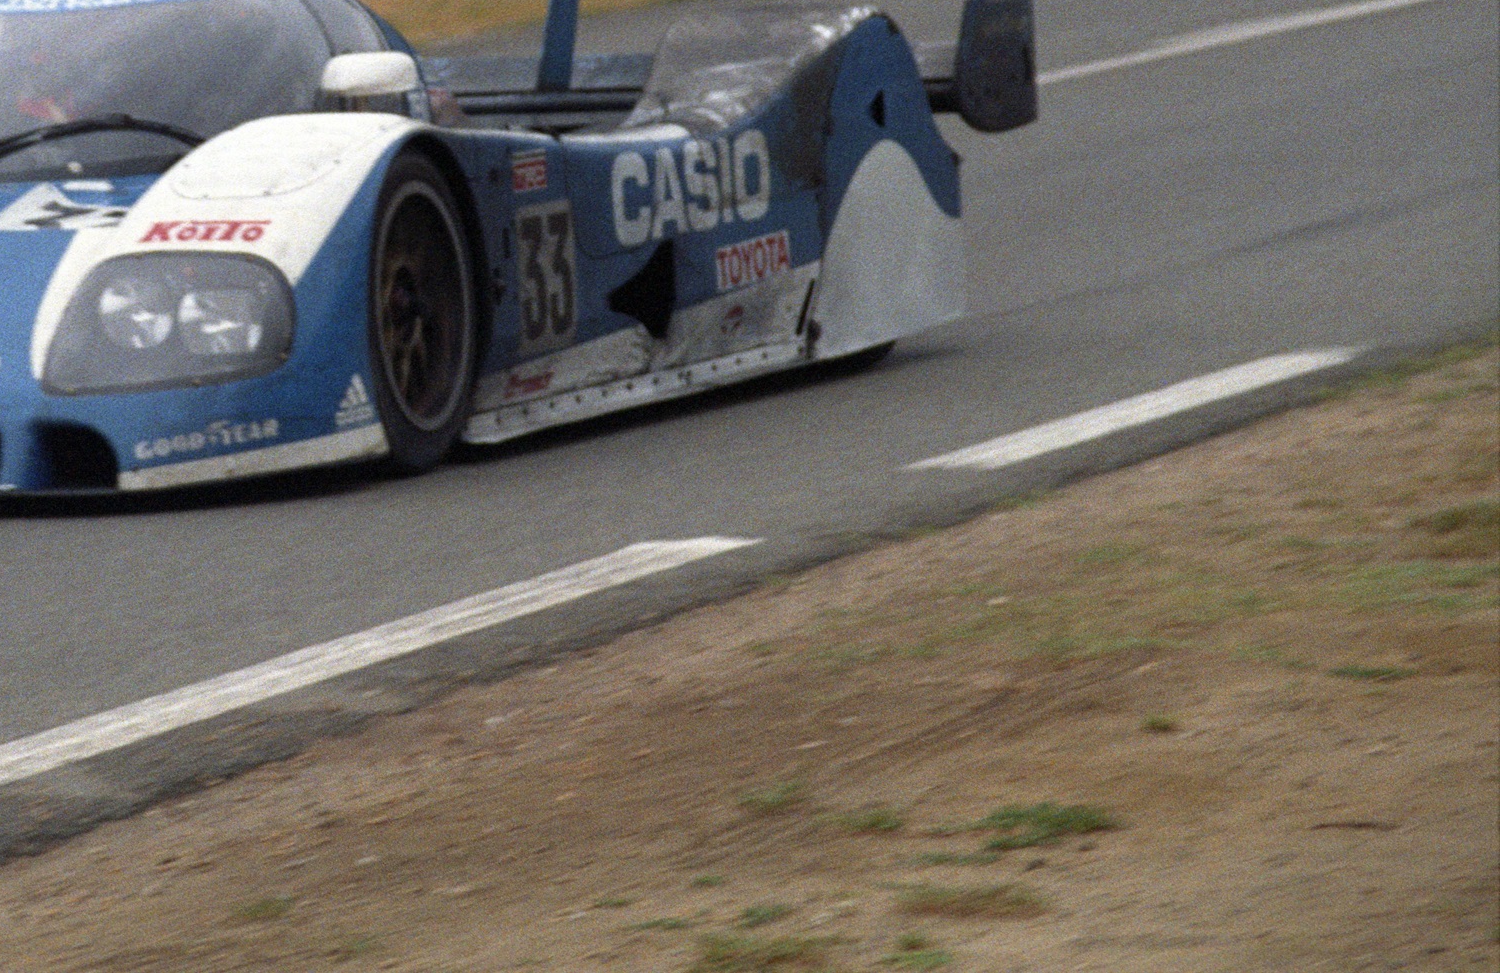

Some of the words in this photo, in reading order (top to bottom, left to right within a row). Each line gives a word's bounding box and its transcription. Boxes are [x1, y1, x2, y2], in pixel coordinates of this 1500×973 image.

[611, 130, 770, 246] CASIO
[521, 212, 574, 340] 33
[717, 232, 791, 290] TOYOTA
